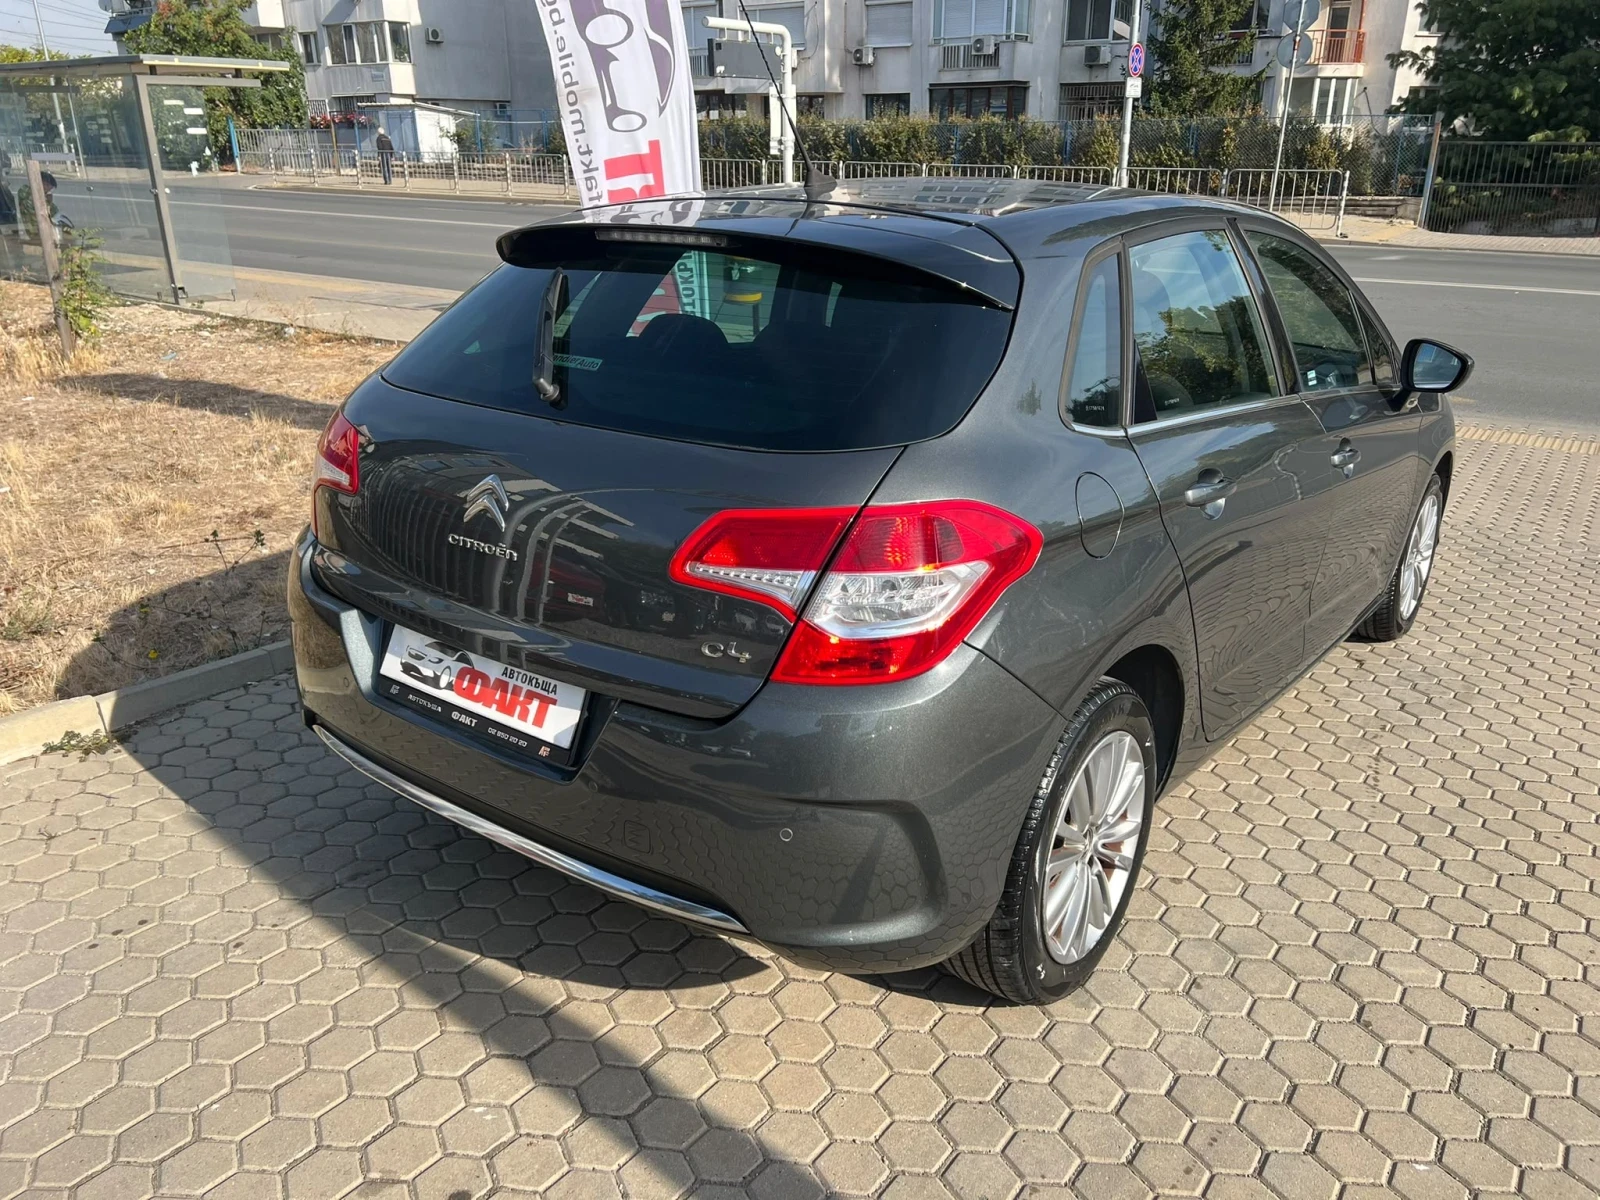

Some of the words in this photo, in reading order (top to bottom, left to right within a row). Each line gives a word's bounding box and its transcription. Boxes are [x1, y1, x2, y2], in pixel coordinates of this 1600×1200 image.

[701, 641, 752, 664] C4
[501, 667, 558, 696] АВТОКЪЩА
[453, 666, 558, 729] ФАКТ
[451, 711, 478, 727] ФАКТ
